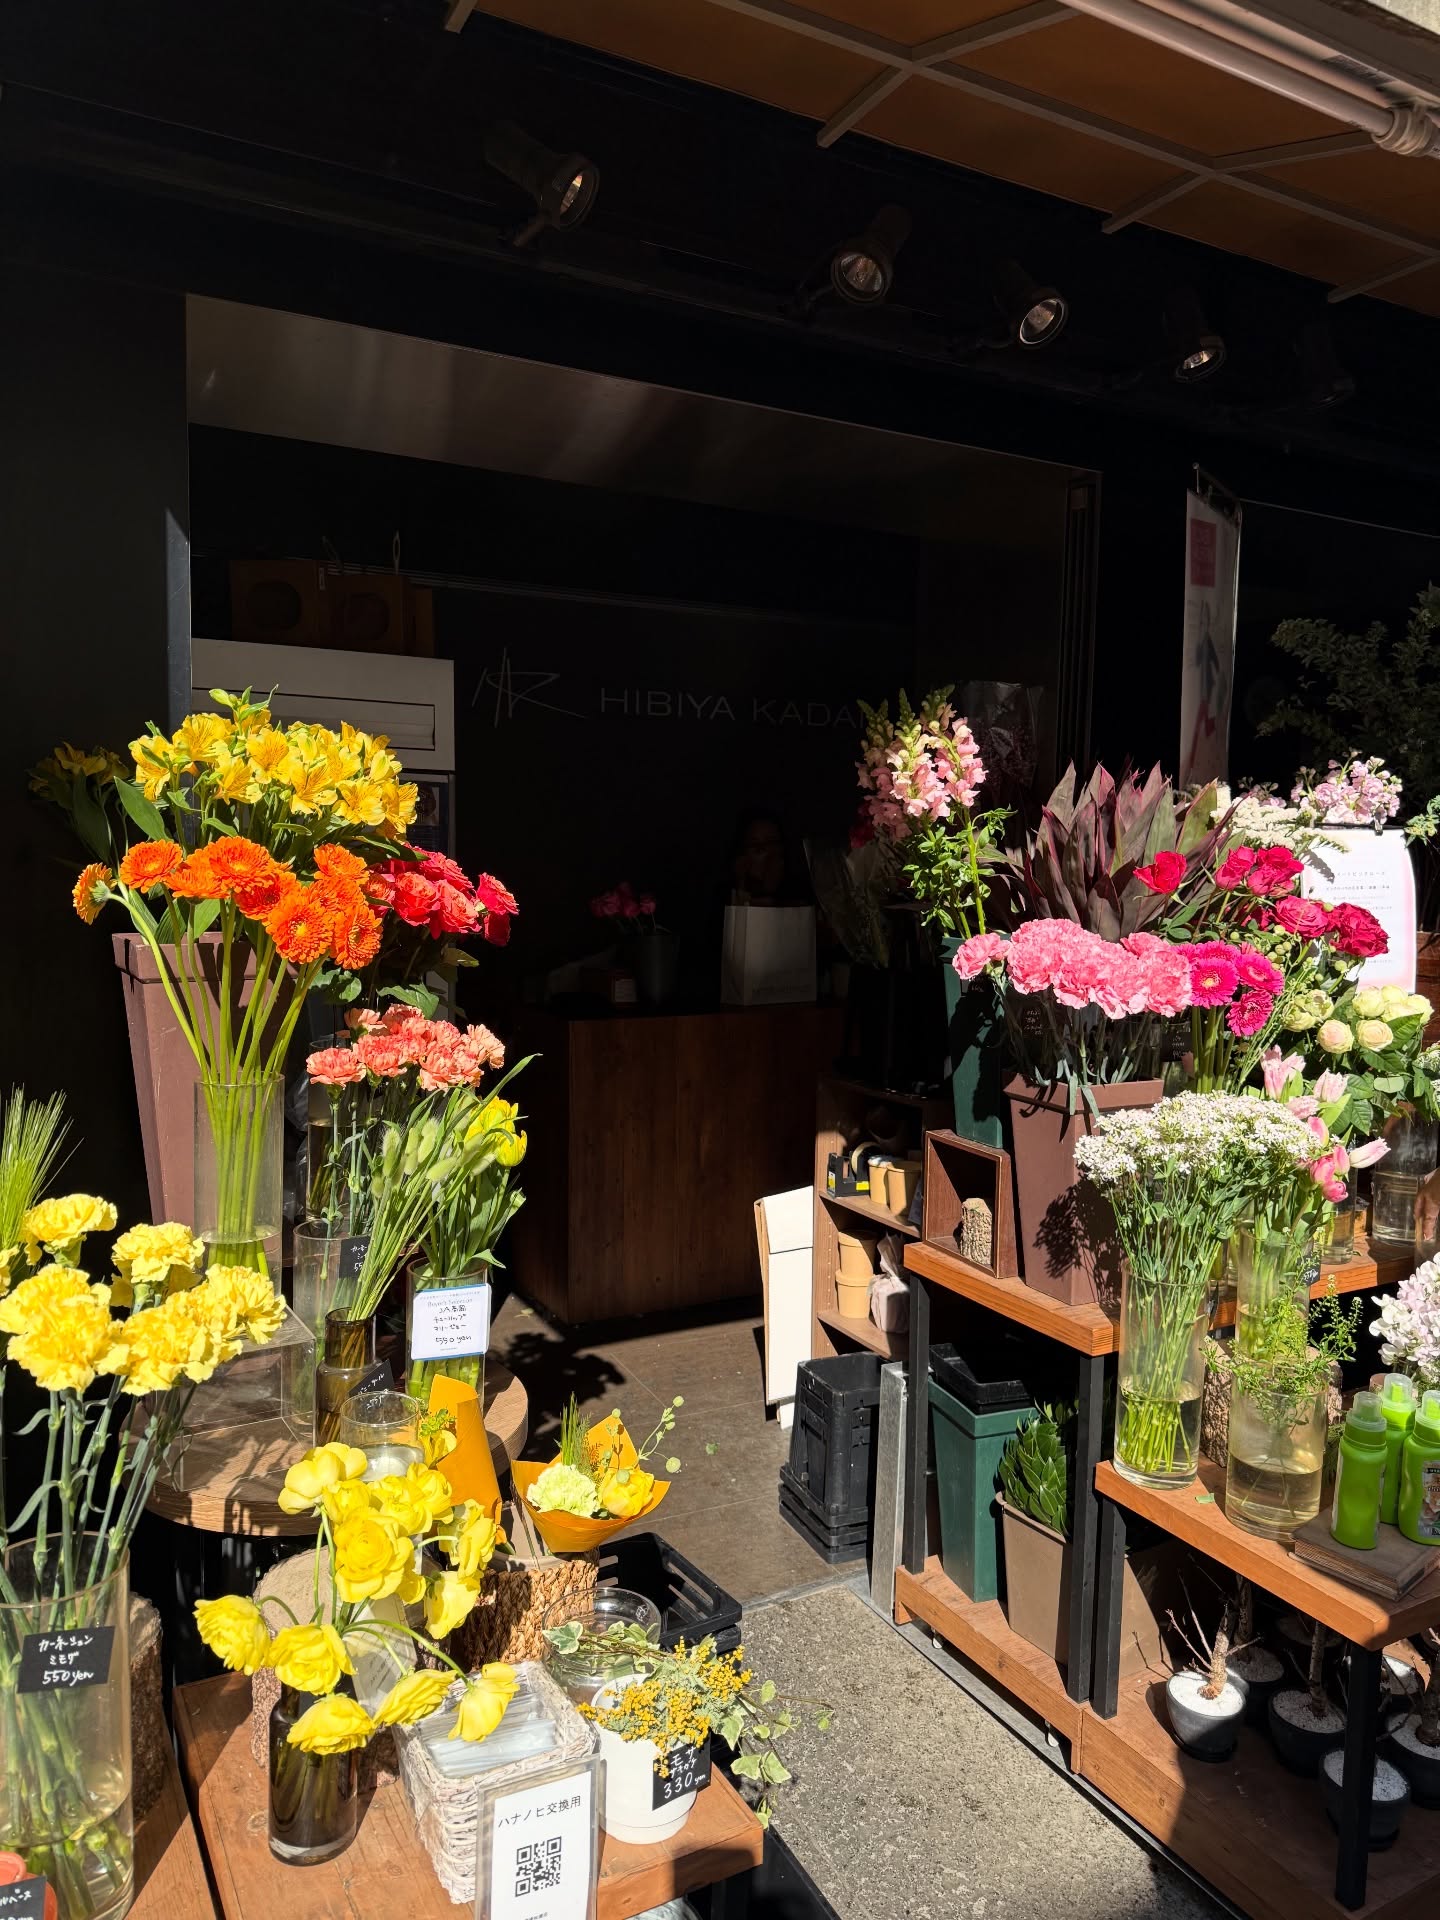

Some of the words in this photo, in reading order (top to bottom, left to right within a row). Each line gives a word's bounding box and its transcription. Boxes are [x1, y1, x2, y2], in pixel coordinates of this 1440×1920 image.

[600, 687, 736, 721] HIBIYA
[435, 1337, 455, 1345] 550
[456, 1335, 472, 1344] yen
[49, 1651, 80, 1665] ミモザ
[663, 1772, 693, 1799] 330
[498, 1795, 581, 1828] ハナノヒ交換用
